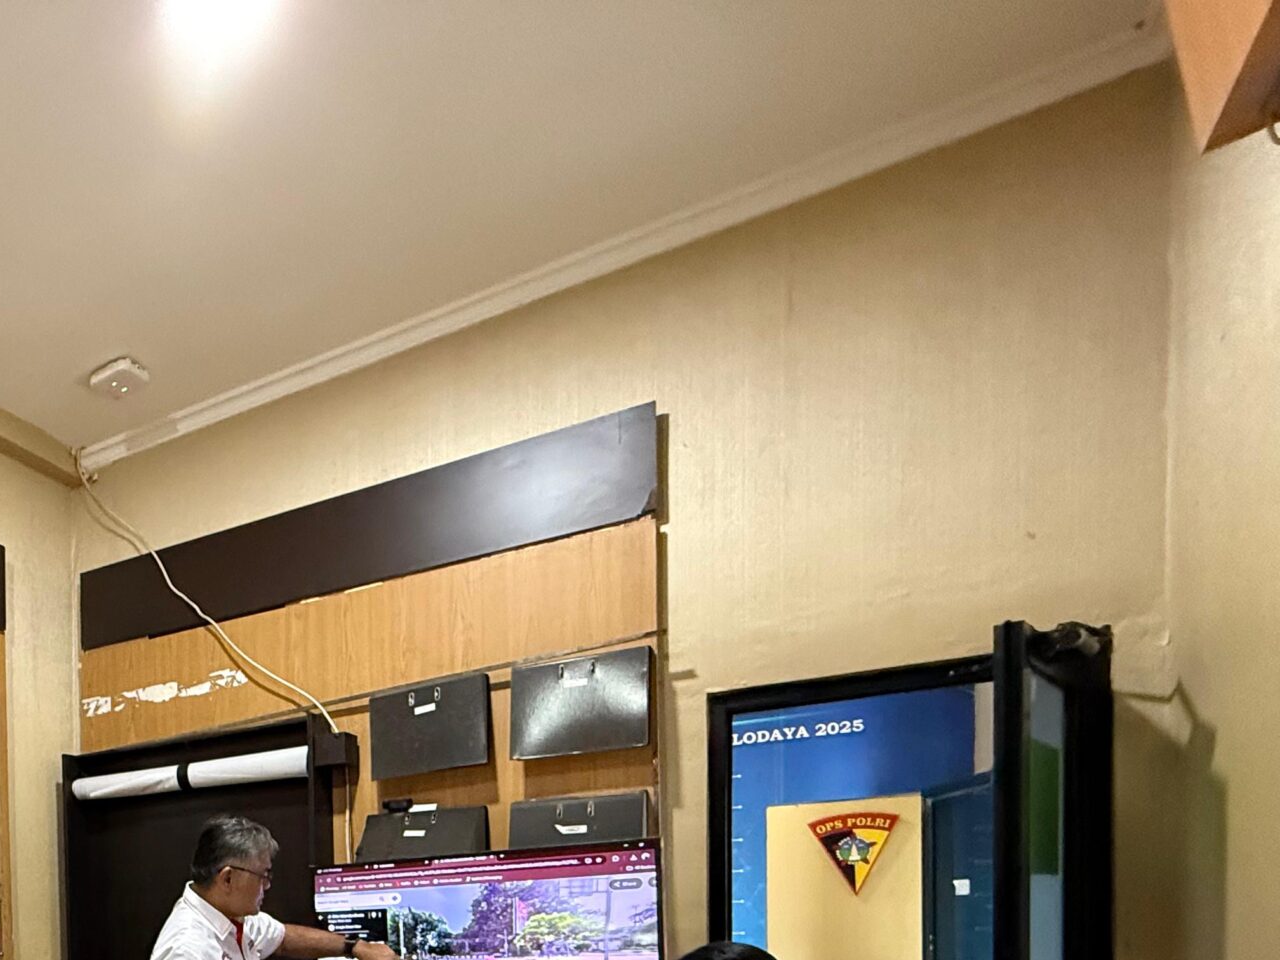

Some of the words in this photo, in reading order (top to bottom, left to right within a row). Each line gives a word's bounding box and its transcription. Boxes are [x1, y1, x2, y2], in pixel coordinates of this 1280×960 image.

[733, 726, 810, 746] LODAYA
[815, 719, 864, 736] 2025
[816, 820, 843, 834] OPS
[847, 817, 891, 828] POLRI
